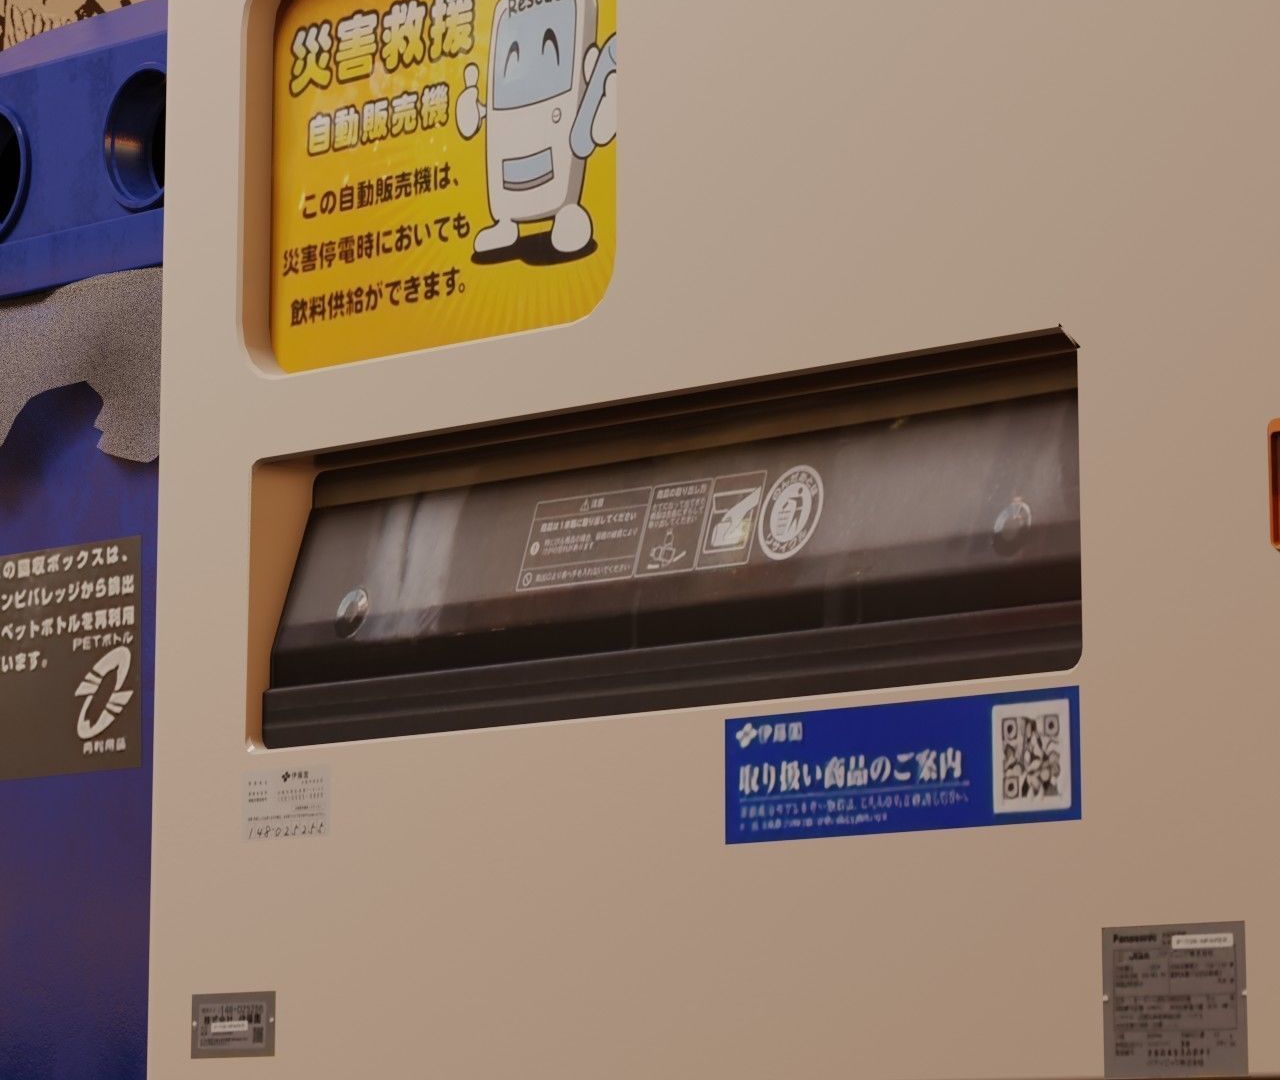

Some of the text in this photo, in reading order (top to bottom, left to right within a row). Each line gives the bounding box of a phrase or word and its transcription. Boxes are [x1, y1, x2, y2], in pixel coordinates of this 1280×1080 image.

[307, 81, 450, 157] 自動販売機
[301, 162, 461, 220] この自動販売機は、
[282, 212, 471, 277] 災害停電時においても
[289, 267, 467, 327] 飲料供給ができます。
[73, 631, 133, 651] PETボトル
[738, 747, 963, 796] 取り扱い商品のご案内
